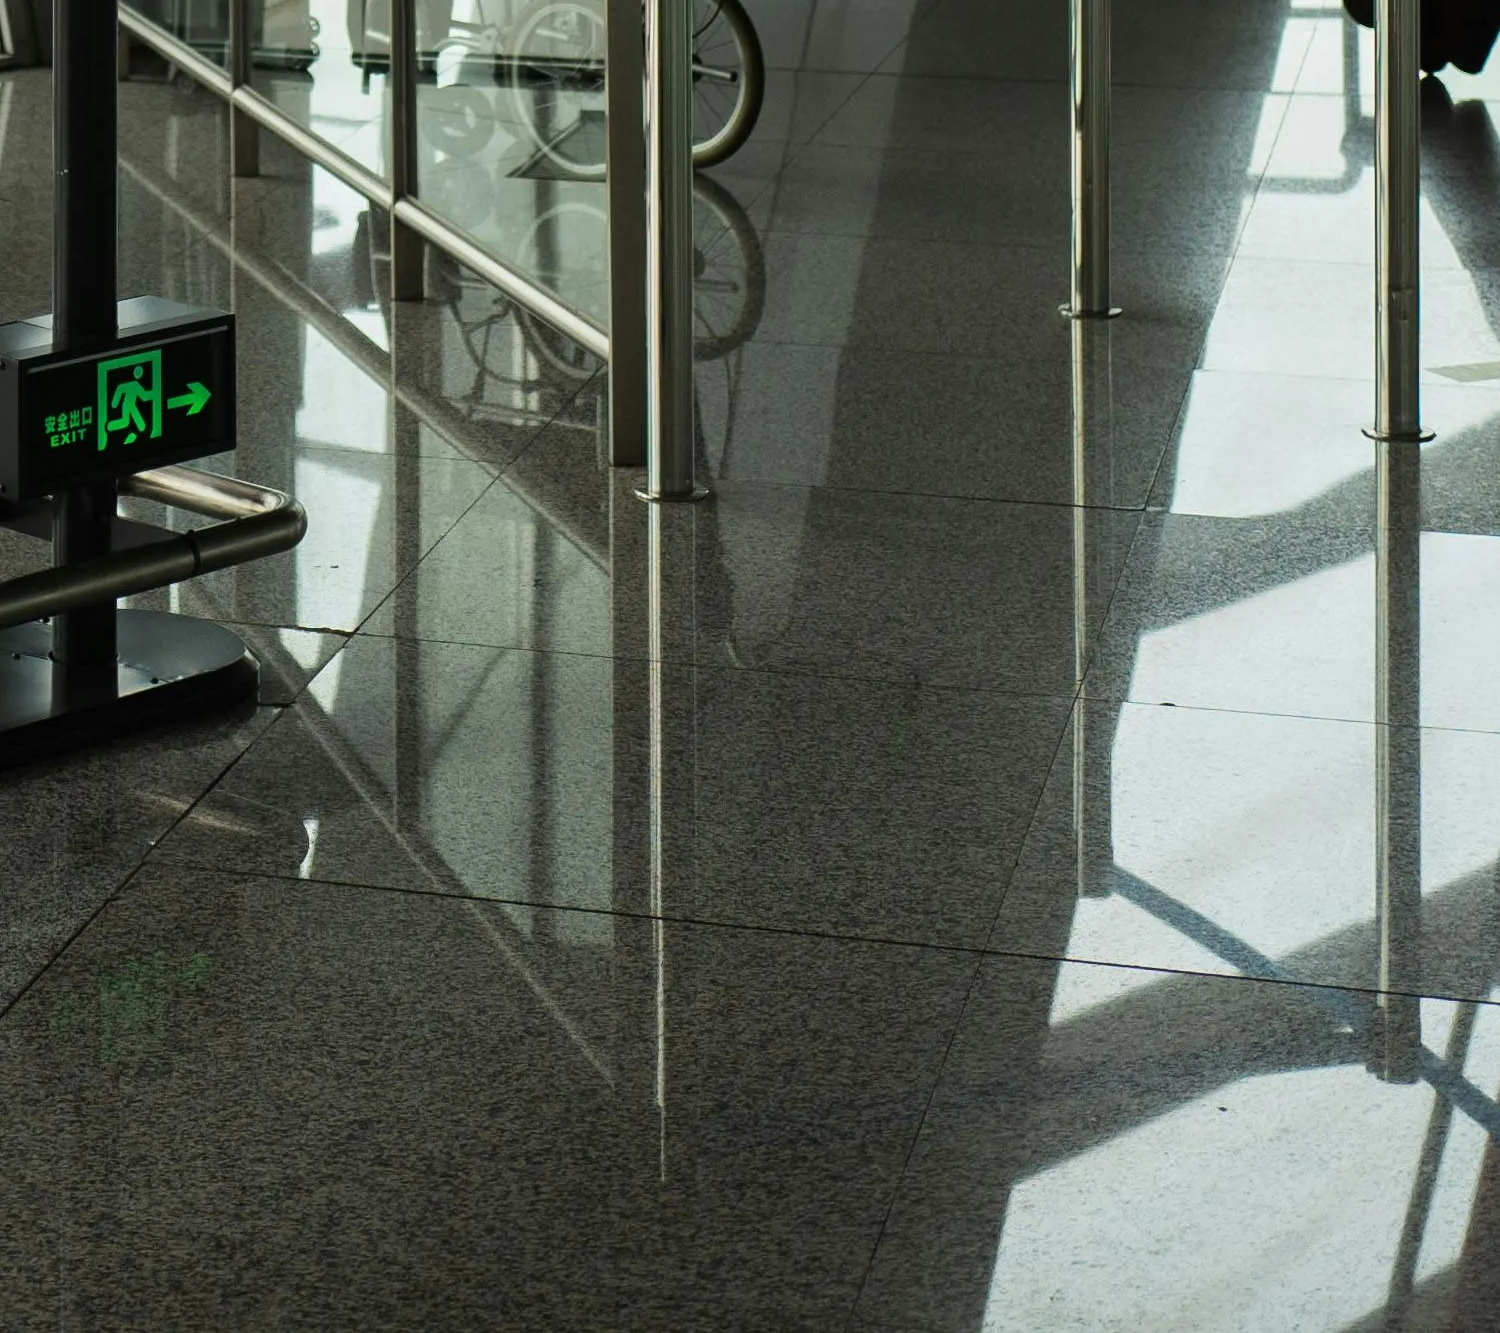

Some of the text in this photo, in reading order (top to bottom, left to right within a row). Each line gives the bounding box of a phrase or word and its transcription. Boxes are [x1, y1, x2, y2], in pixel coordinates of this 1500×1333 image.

[44, 406, 92, 434] 安全出口
[51, 428, 87, 447] EXIT
